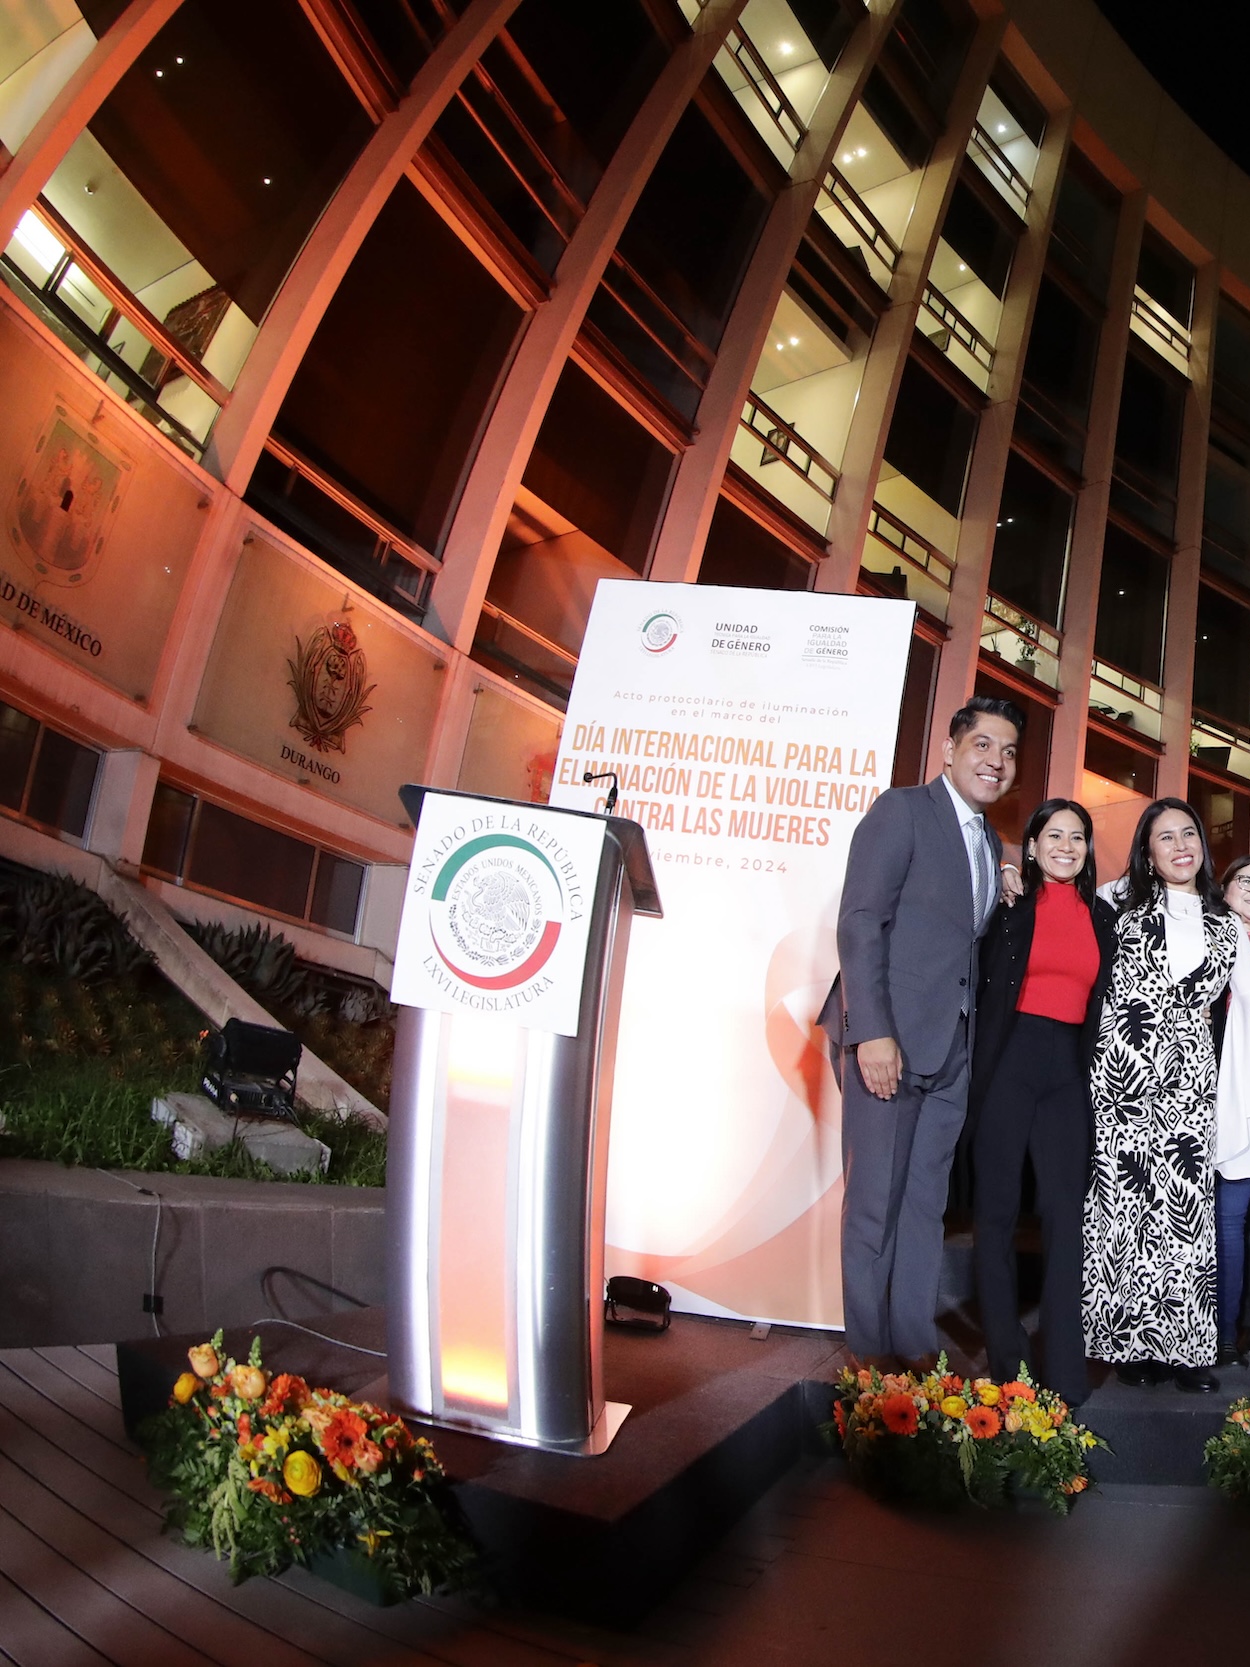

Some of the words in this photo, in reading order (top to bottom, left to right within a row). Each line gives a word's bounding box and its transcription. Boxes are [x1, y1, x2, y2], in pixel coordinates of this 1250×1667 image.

[16, 592, 41, 619] DE
[40, 608, 102, 657] MÉXICO
[715, 622, 758, 634] UNIDAD
[809, 624, 850, 634] COMISIÓN
[711, 638, 726, 649] DE
[726, 638, 771, 652] GÉNERO
[807, 639, 847, 648] IGUALDAD
[816, 647, 849, 657] GÉNERO
[613, 690, 643, 701] Acto
[648, 694, 733, 708] protocolario
[740, 699, 756, 710] de
[762, 701, 849, 717] iluminación
[671, 708, 687, 717] en
[692, 709, 704, 718] el
[711, 712, 753, 722] marco
[759, 714, 781, 724] del
[280, 745, 340, 784] DURANGO
[572, 720, 606, 753] DÍA
[610, 727, 777, 769] INTERNACIONAL
[783, 742, 842, 775] PARA
[849, 748, 877, 778] LA
[558, 757, 692, 797] ELIMINACIÓN
[696, 770, 726, 800] DE
[730, 773, 756, 803] LA
[681, 805, 723, 836] LAS
[727, 809, 832, 847] MUJERES
[413, 825, 466, 896] SENADO
[471, 815, 495, 833] DE
[500, 815, 521, 832] LA
[526, 823, 584, 922] REPÚBLICA
[740, 857, 788, 875] 2024
[451, 864, 479, 901] ESTADOS
[481, 857, 514, 869] UNIDOS
[515, 864, 543, 916] MEXICANOS
[422, 955, 452, 993] LXVI
[451, 975, 555, 1012] LEGISLATURA
